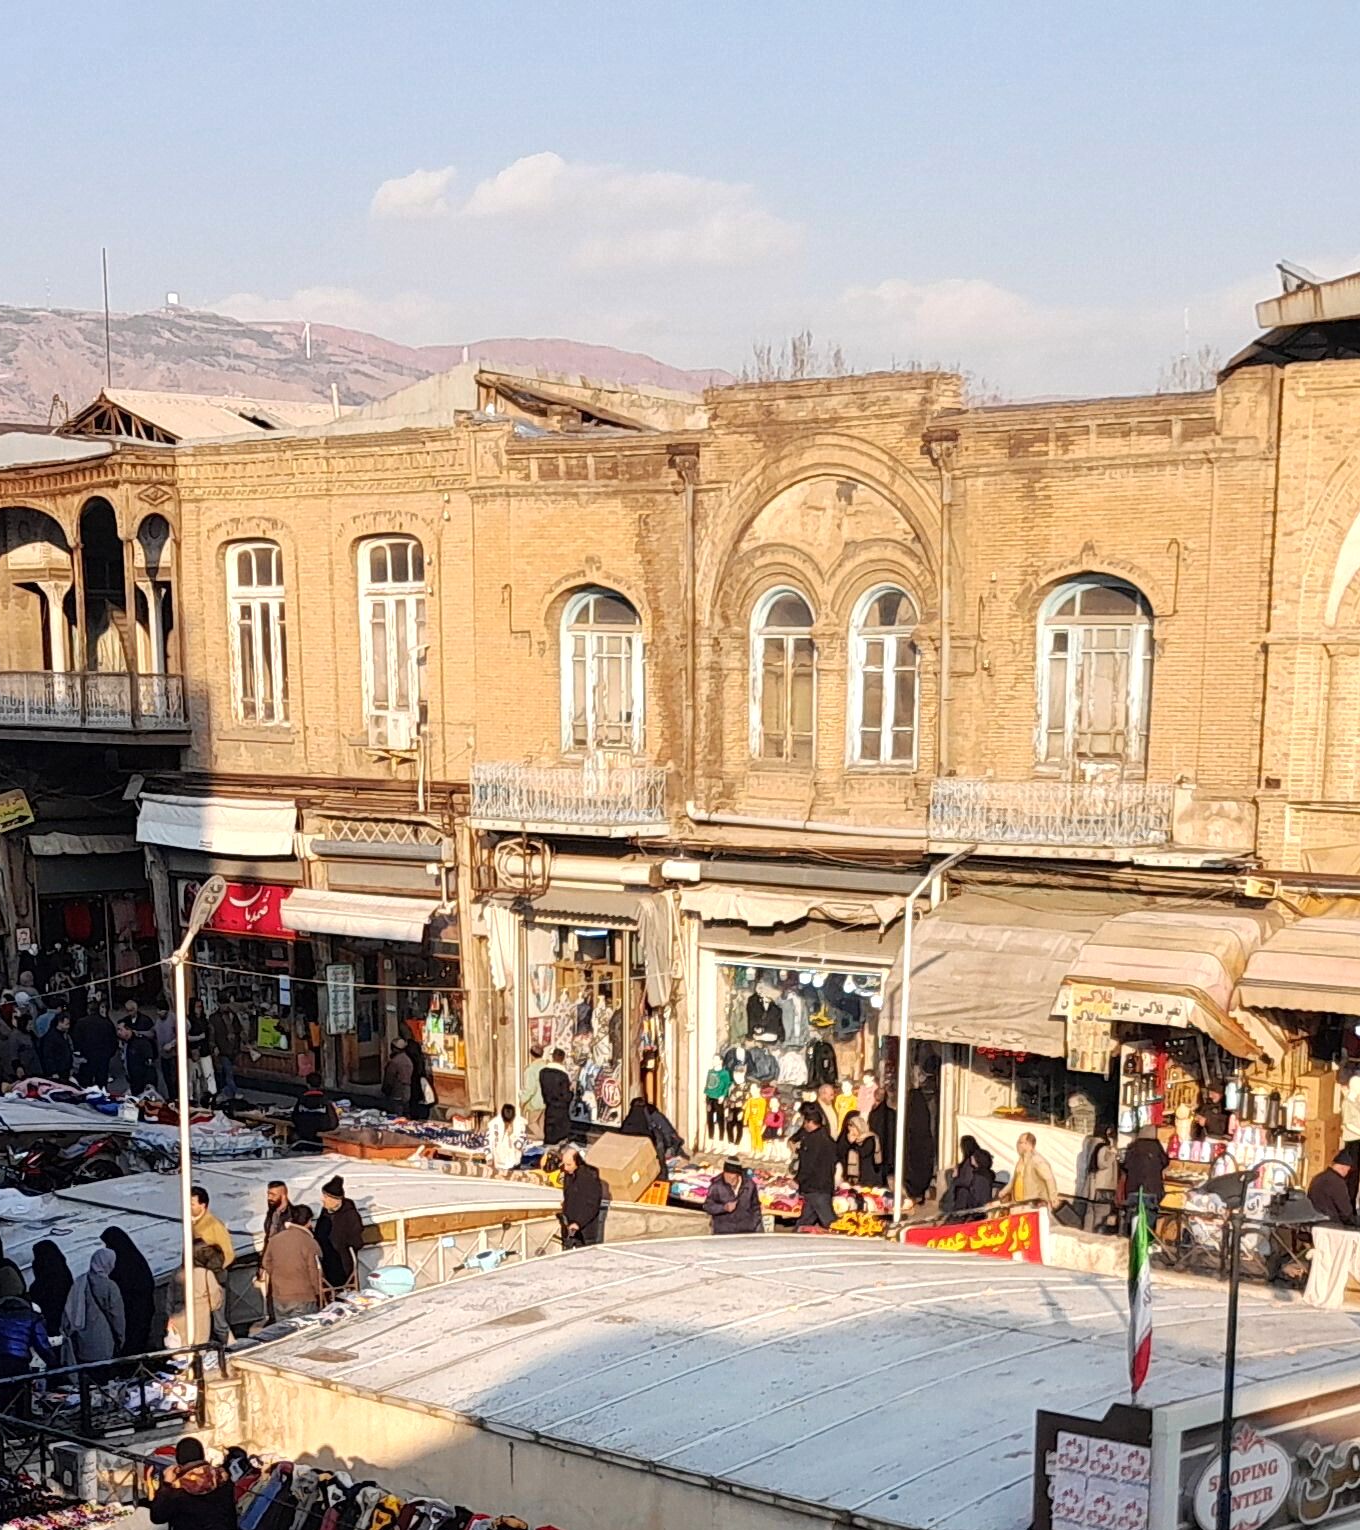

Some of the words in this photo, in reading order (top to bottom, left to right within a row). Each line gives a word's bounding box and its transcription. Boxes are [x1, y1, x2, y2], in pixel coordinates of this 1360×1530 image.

[1073, 989, 1113, 1006] فلاکس
[969, 1215, 1031, 1253] پارکینگ
[1208, 1458, 1279, 1493] SOPING
[1211, 1486, 1274, 1518] CNTER
